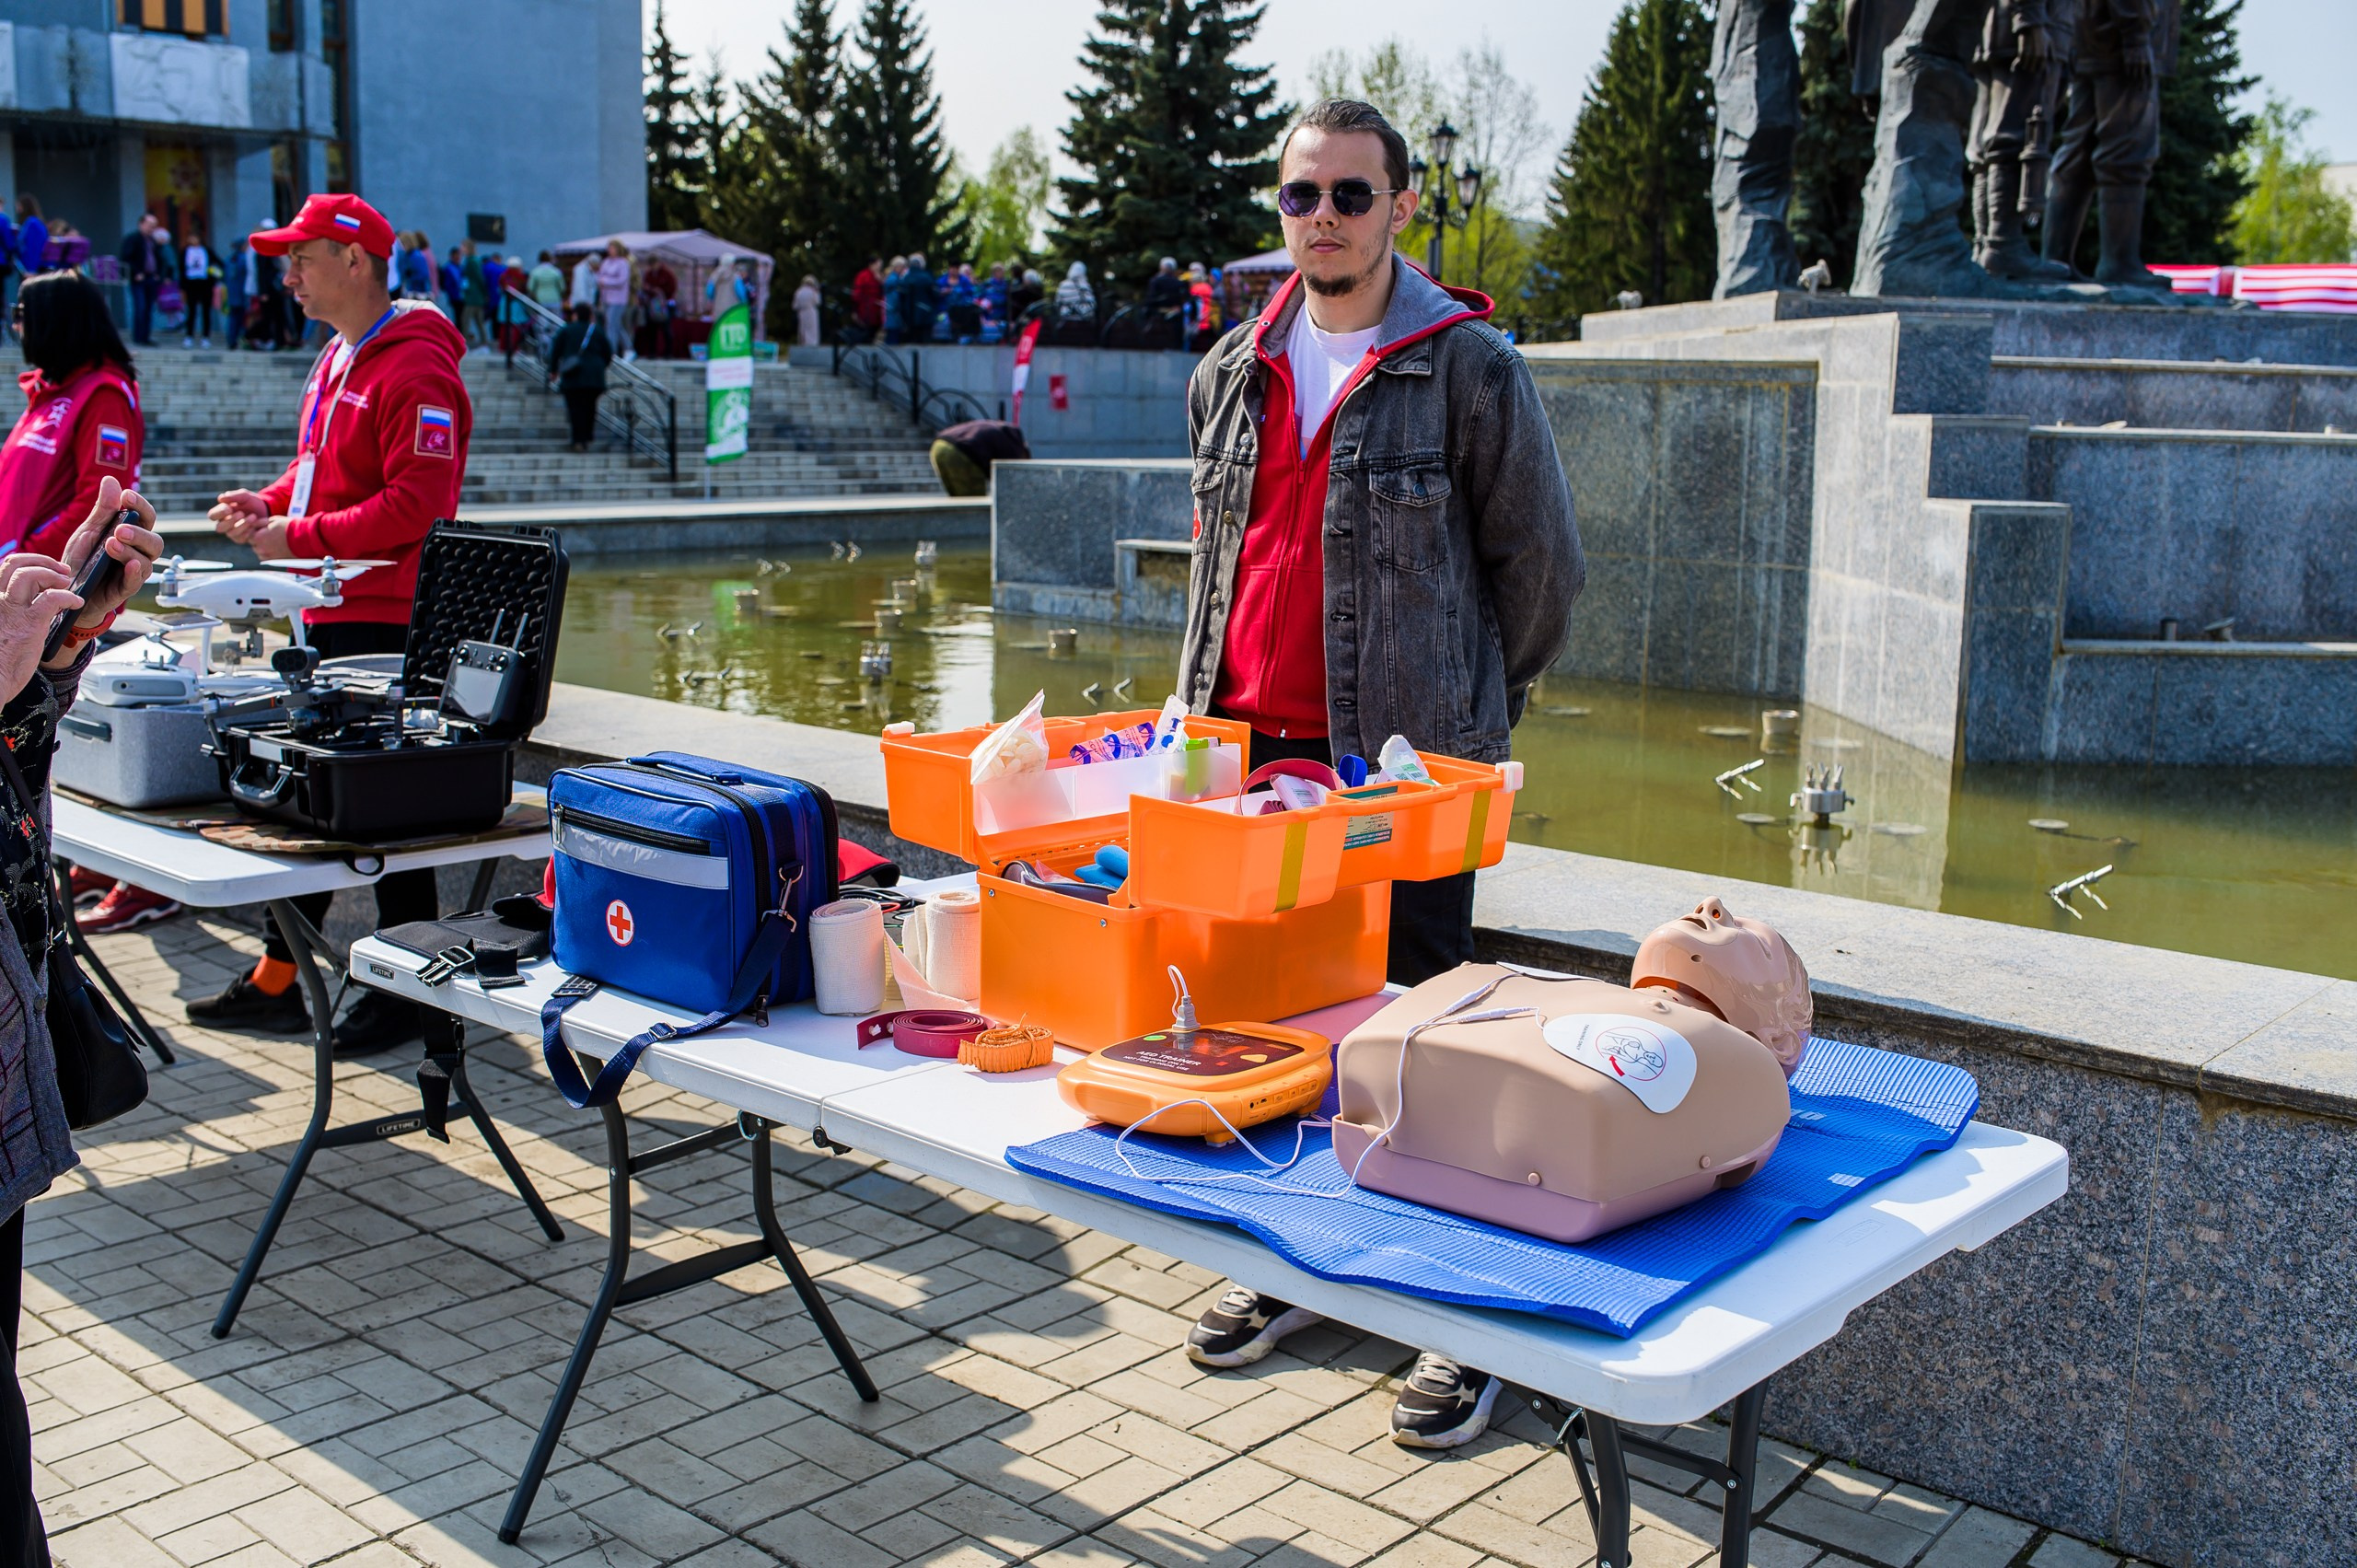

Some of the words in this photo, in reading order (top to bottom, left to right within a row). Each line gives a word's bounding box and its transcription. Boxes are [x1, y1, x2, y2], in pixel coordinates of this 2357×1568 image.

[1140, 1055, 1168, 1063] TRAINING
[1159, 1054, 1202, 1066] TRAINER
[1149, 1060, 1175, 1068] CLINICAL
[382, 1121, 414, 1132] LIFETIME
